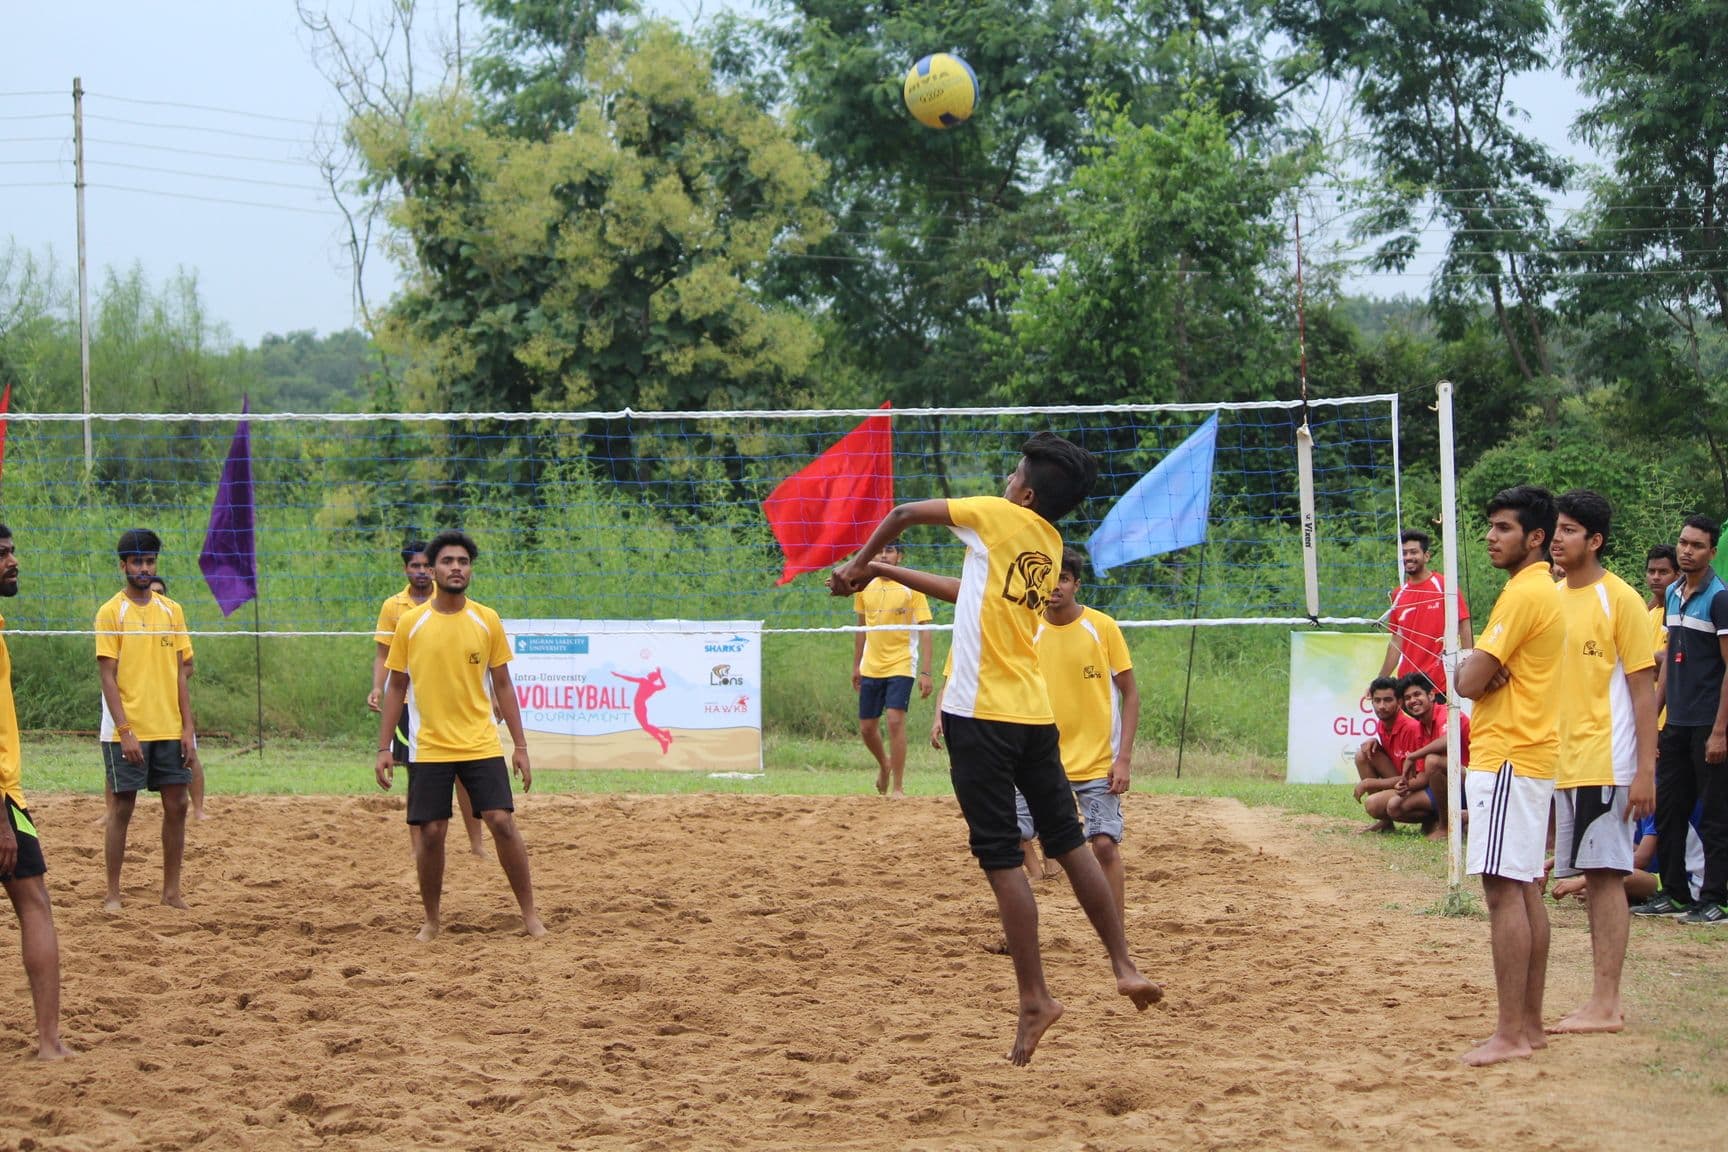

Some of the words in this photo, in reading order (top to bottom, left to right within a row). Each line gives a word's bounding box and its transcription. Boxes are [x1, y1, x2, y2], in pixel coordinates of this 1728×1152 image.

[1304, 522, 1313, 548] Vixen
[704, 644, 742, 652] SHARKS
[710, 672, 743, 686] Lions
[516, 685, 631, 709] VOLLEYBALL
[521, 711, 632, 722] TOURNAMENT
[1333, 717, 1378, 736] GLO
